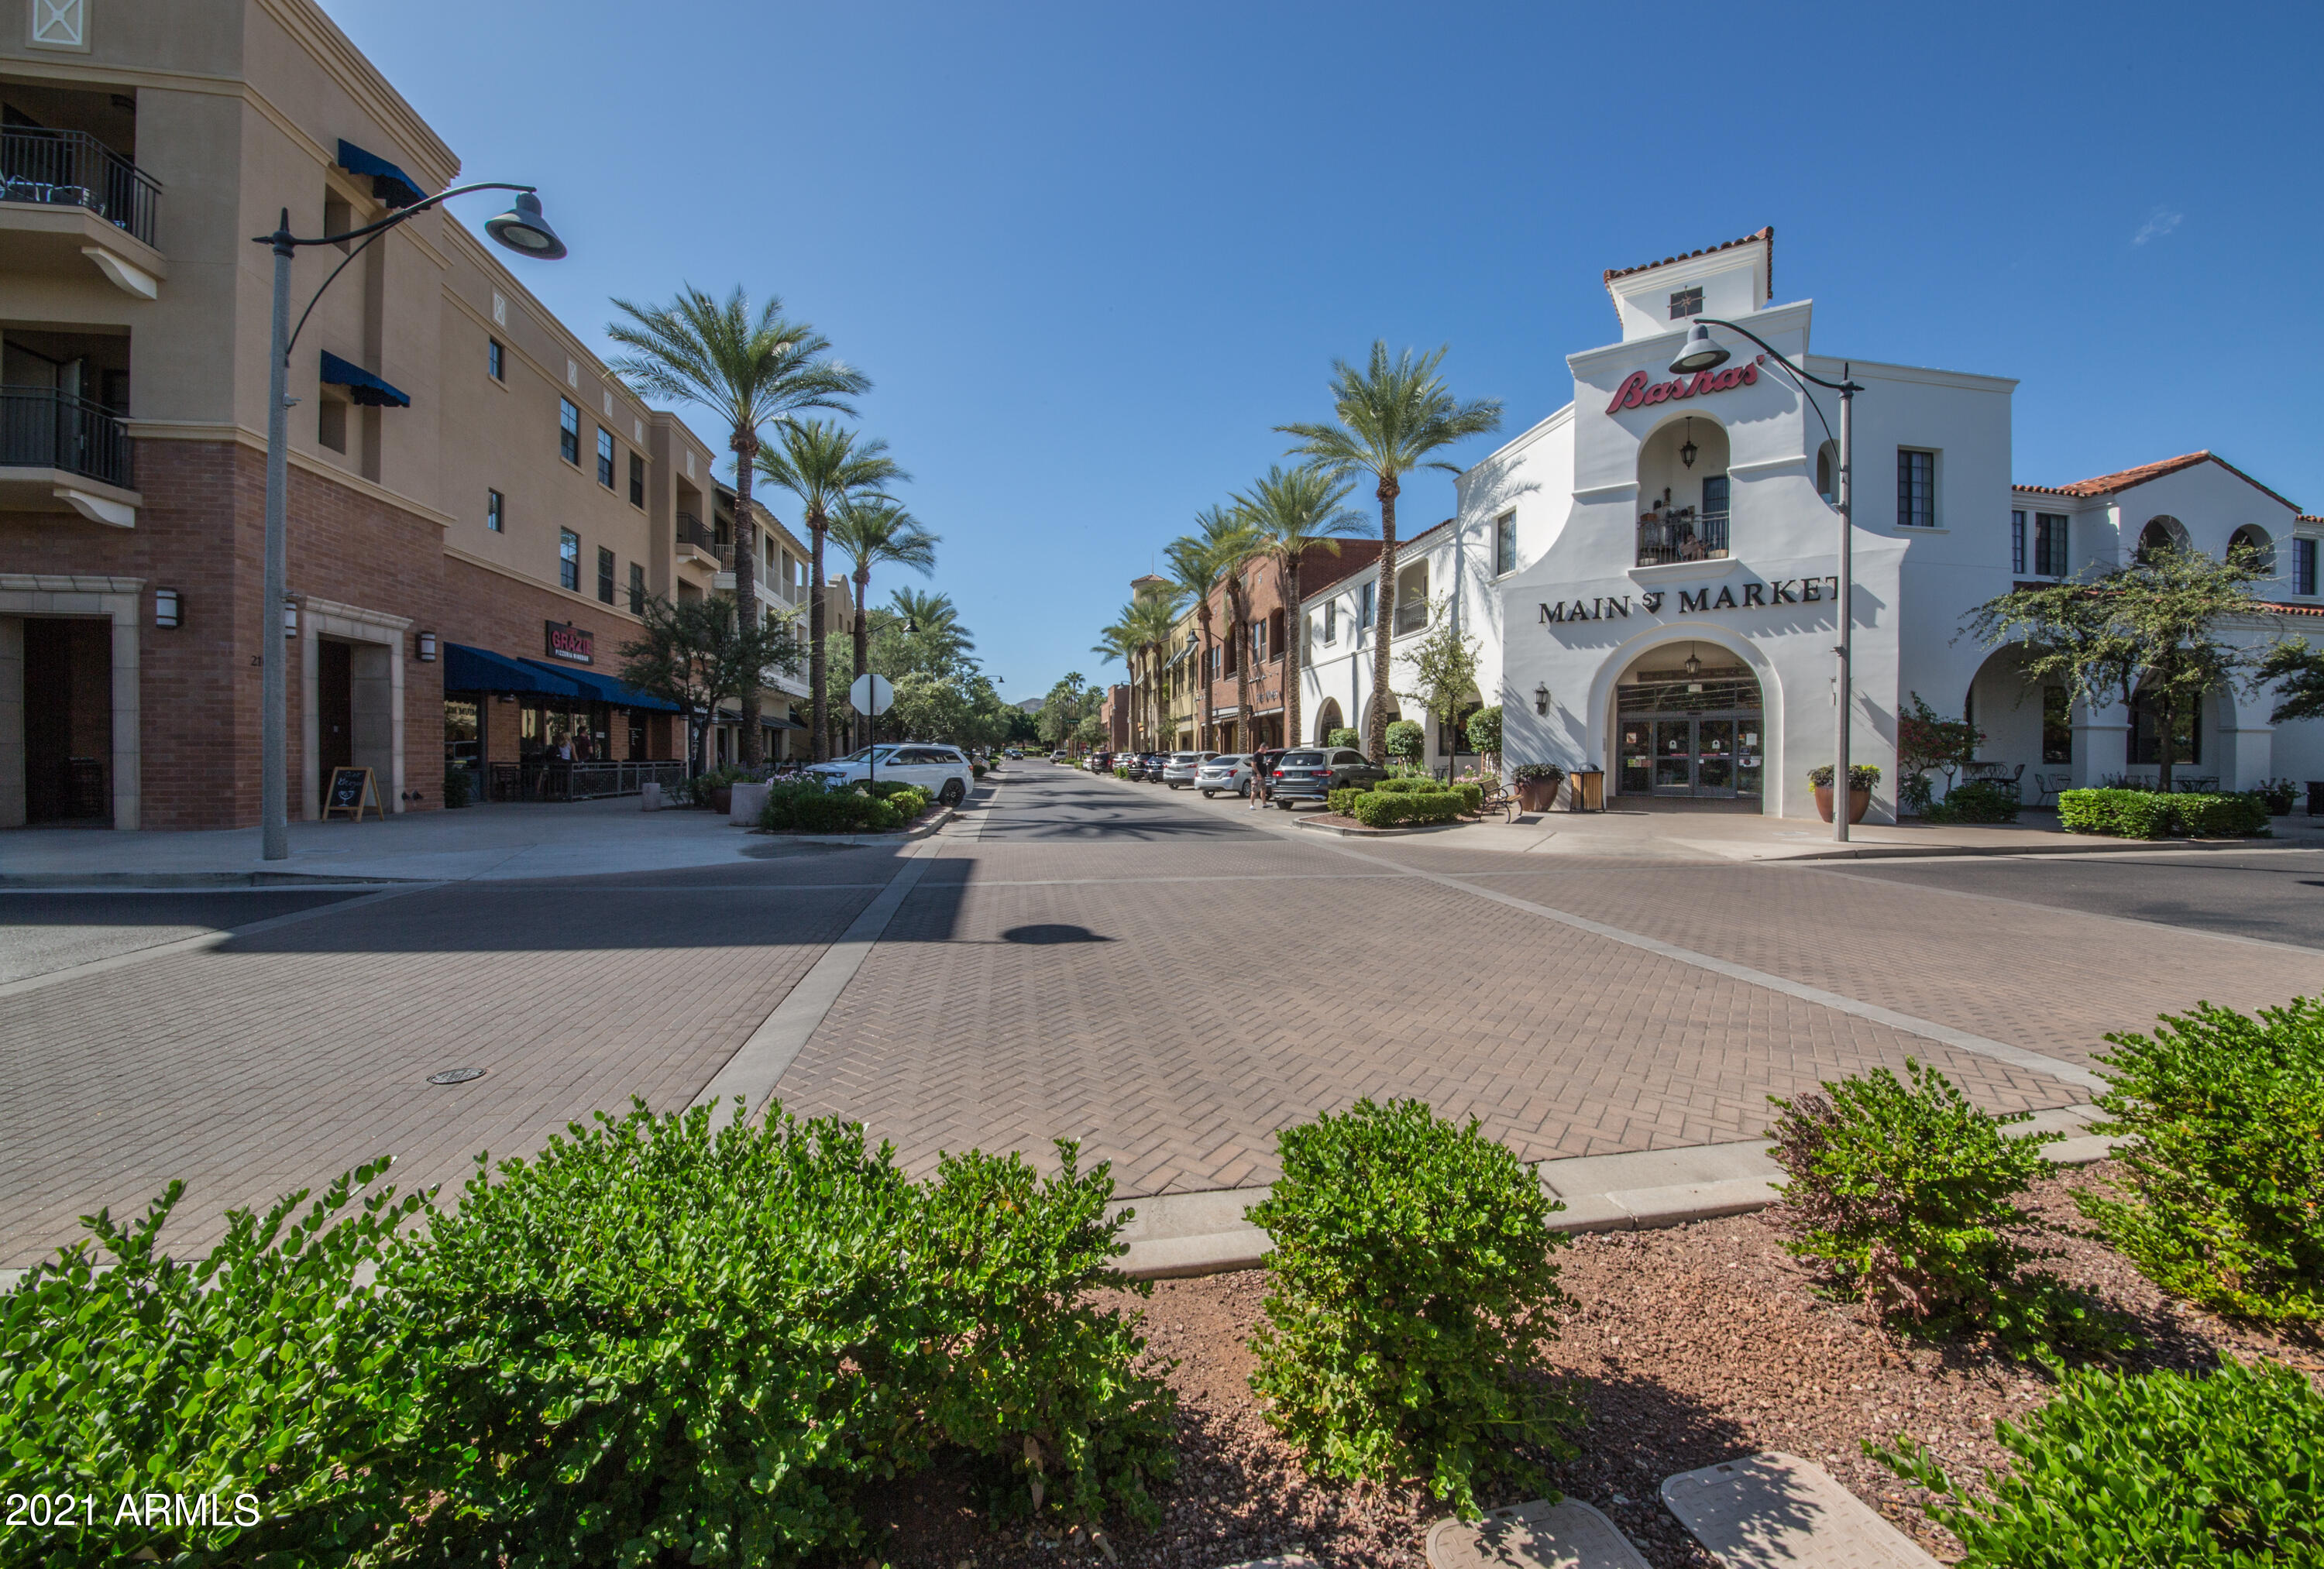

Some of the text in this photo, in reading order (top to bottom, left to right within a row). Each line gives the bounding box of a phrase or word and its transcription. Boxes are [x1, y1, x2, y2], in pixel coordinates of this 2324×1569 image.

[1538, 596, 1630, 623] MAIN
[1642, 592, 1665, 607] ST
[552, 630, 593, 656] GRAZIE
[250, 655, 264, 667] 21
